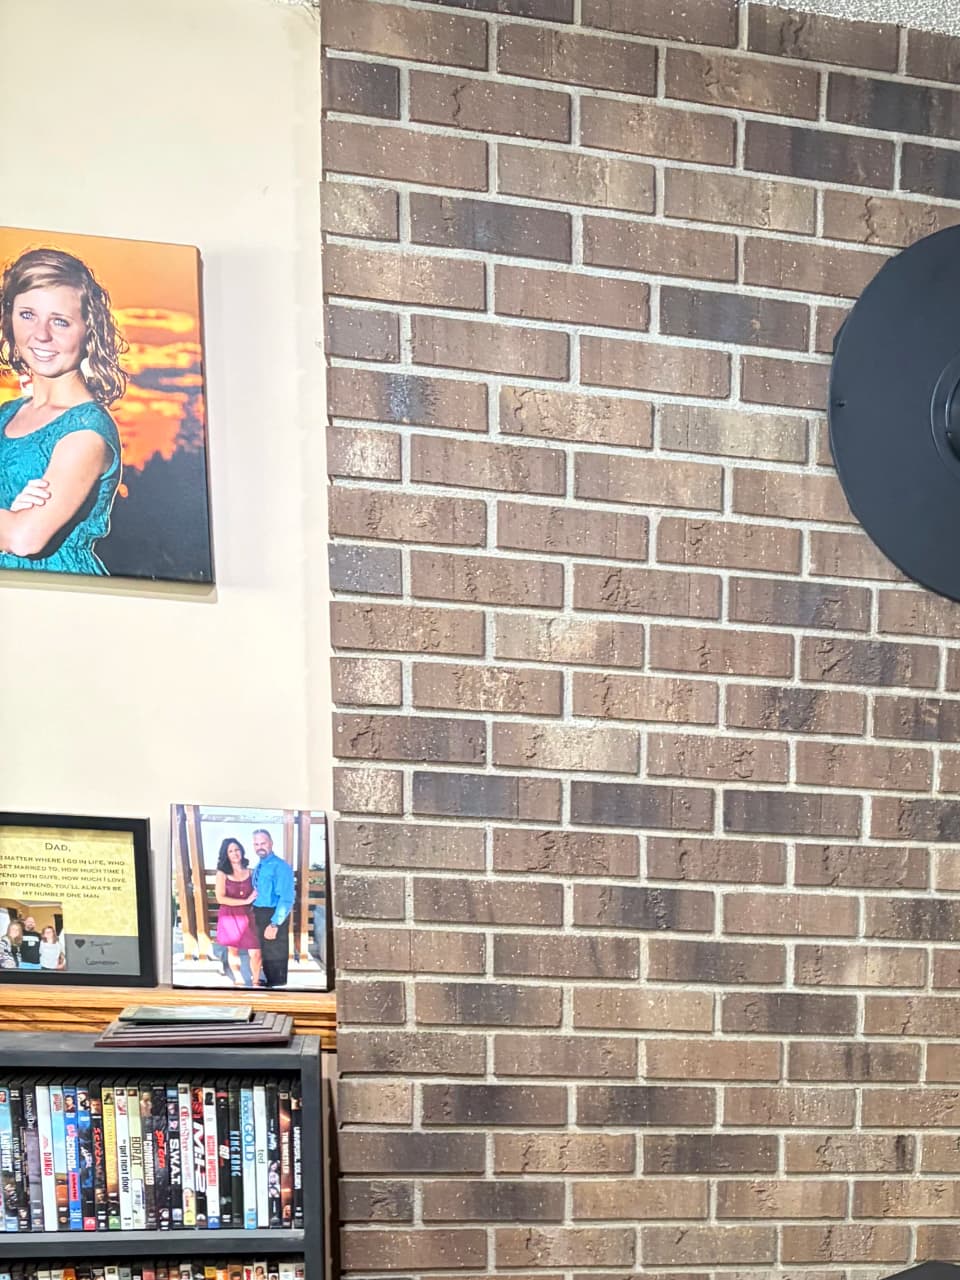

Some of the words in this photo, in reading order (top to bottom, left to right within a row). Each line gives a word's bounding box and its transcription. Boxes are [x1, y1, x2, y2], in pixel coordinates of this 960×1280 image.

[45, 842, 71, 852] DAD,
[66, 1136, 77, 1171] SCHOOL
[131, 1136, 142, 1167] BORAT
[230, 1130, 240, 1152] KING
[244, 1123, 255, 1161] GOLD
[43, 1152, 52, 1176] DJANGO
[143, 1140, 155, 1185] CONDEMNED
[169, 1138, 181, 1185] S.W.A.T.
[231, 1154, 241, 1177] KONG
[257, 1149, 265, 1164] ted
[282, 1143, 290, 1174] WRESTLER
[121, 1176, 130, 1193] door
[294, 1162, 302, 1189] SOLDIER
